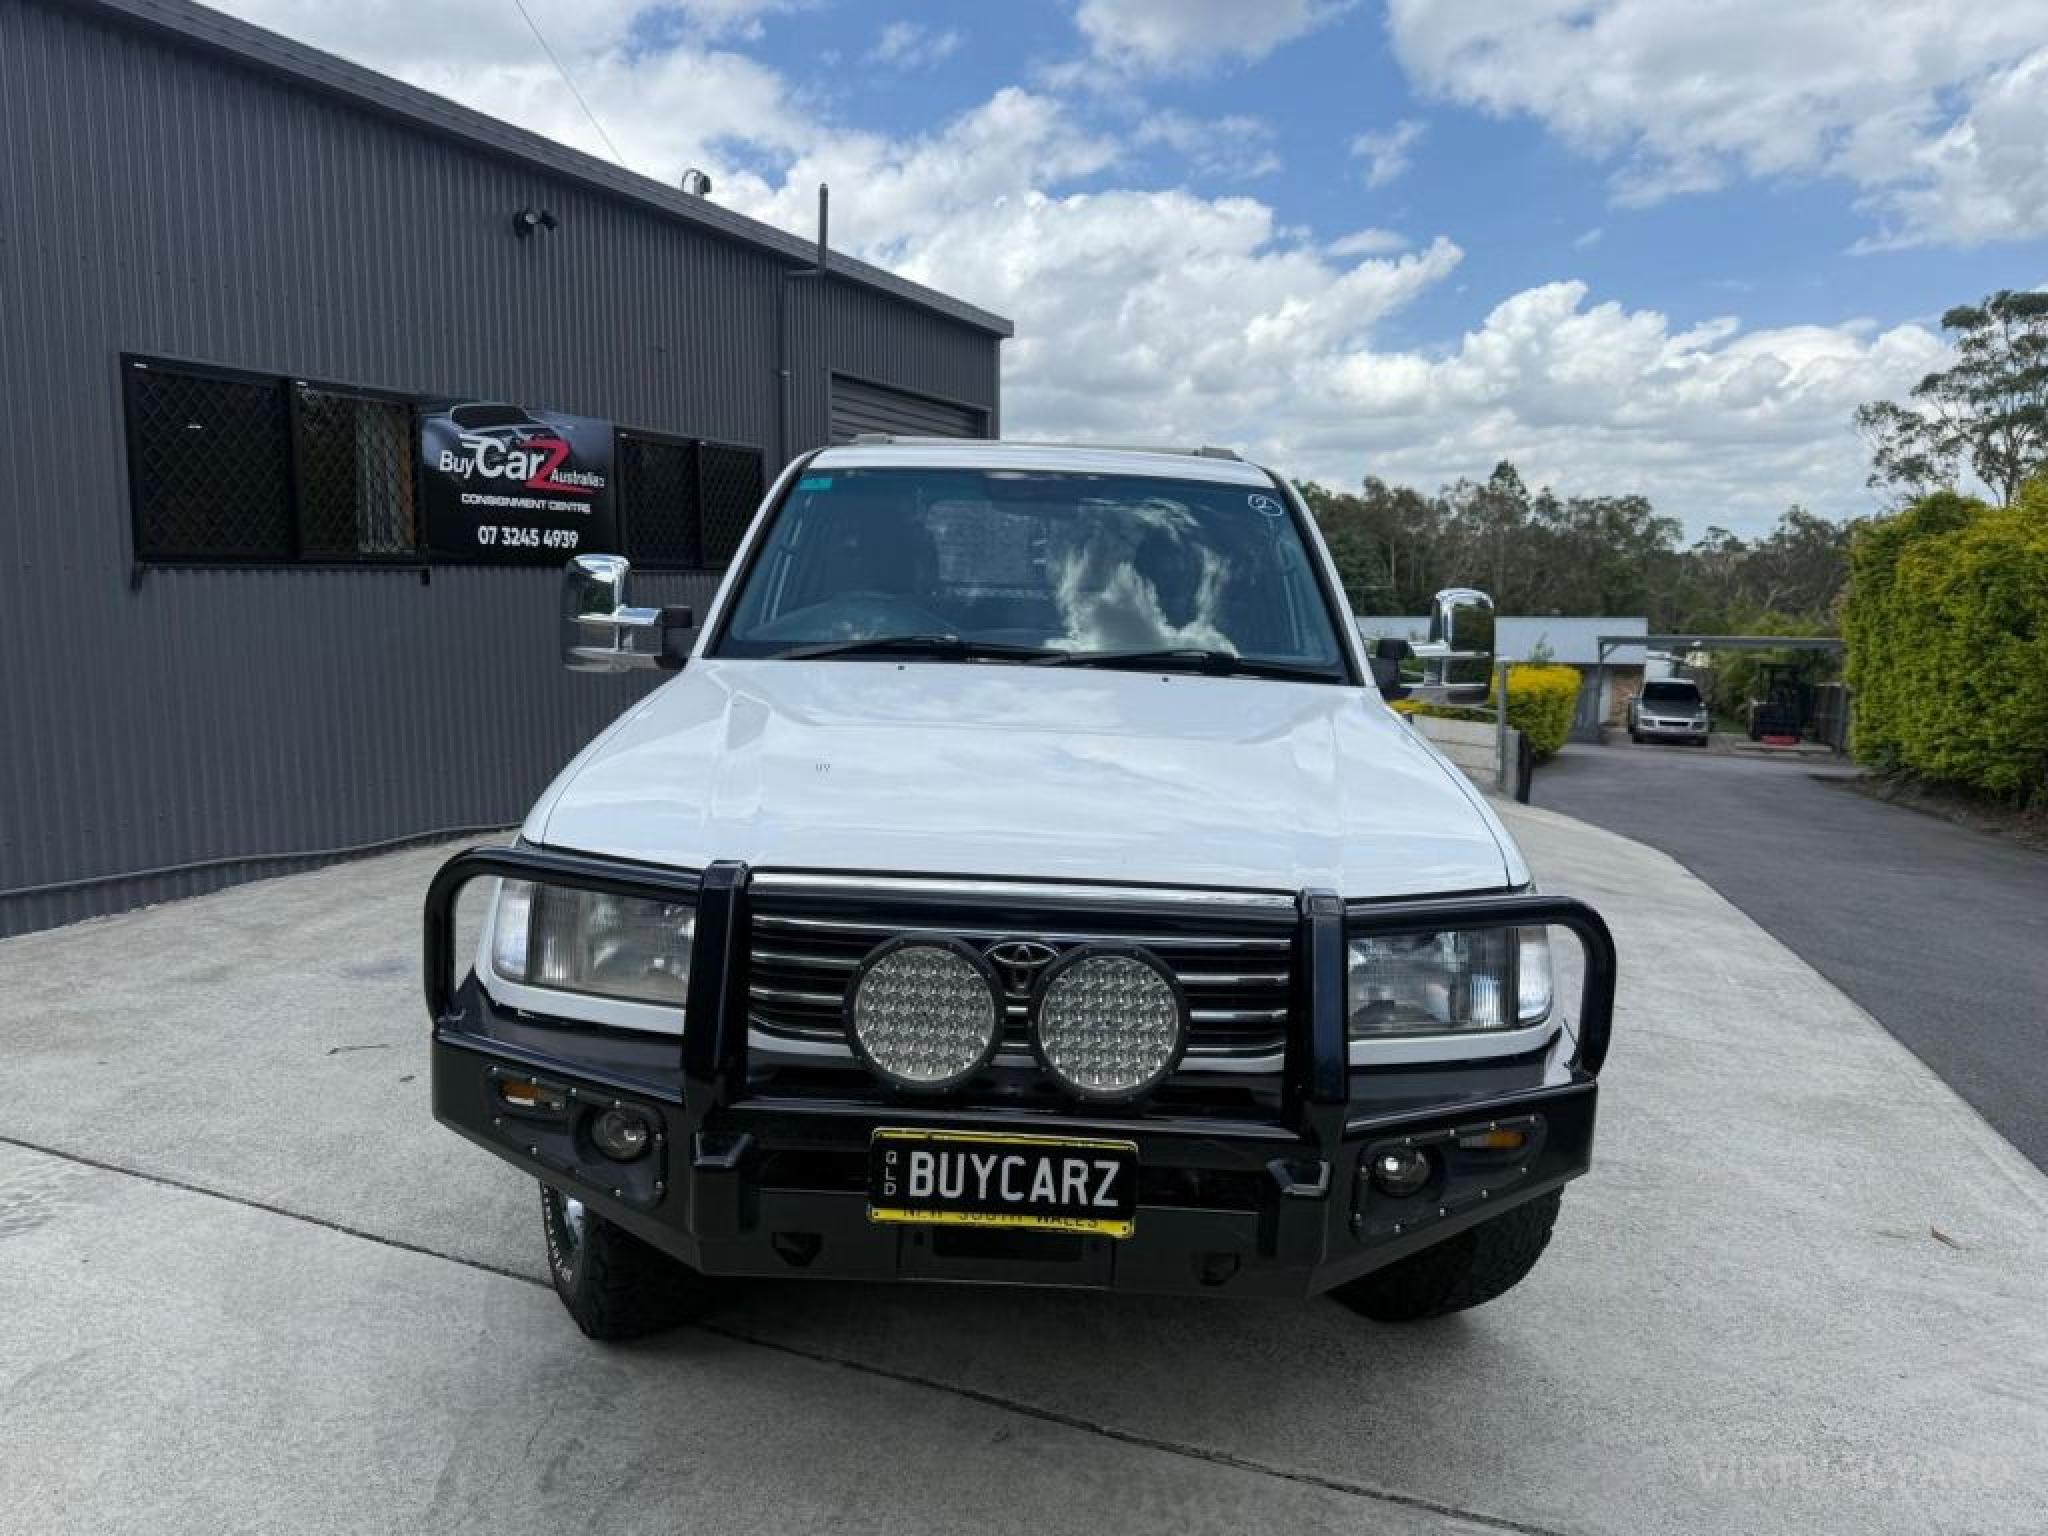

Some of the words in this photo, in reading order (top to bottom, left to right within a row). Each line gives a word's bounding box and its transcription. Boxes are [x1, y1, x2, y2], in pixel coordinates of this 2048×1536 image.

[478, 526, 497, 545] 07
[502, 526, 540, 547] 3245
[543, 529, 578, 548] 4939
[909, 1151, 1120, 1207] BUYCARZ
